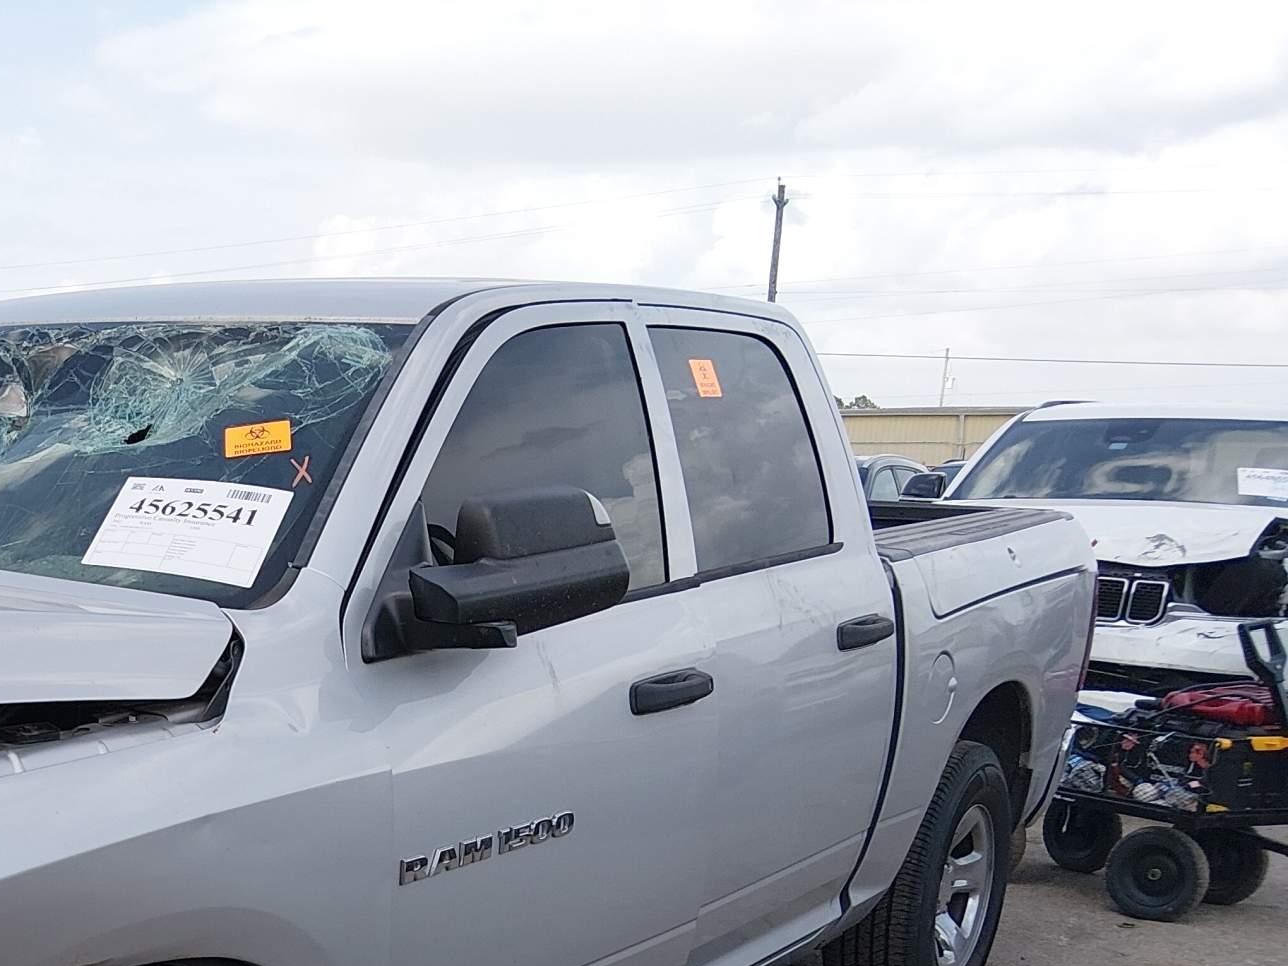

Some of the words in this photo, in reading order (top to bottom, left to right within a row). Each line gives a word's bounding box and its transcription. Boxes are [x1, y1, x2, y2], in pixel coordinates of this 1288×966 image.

[234, 439, 282, 449] BIOHAZARD
[128, 498, 258, 527] 45625541
[399, 833, 493, 886] RAM
[497, 810, 575, 855] 1500
